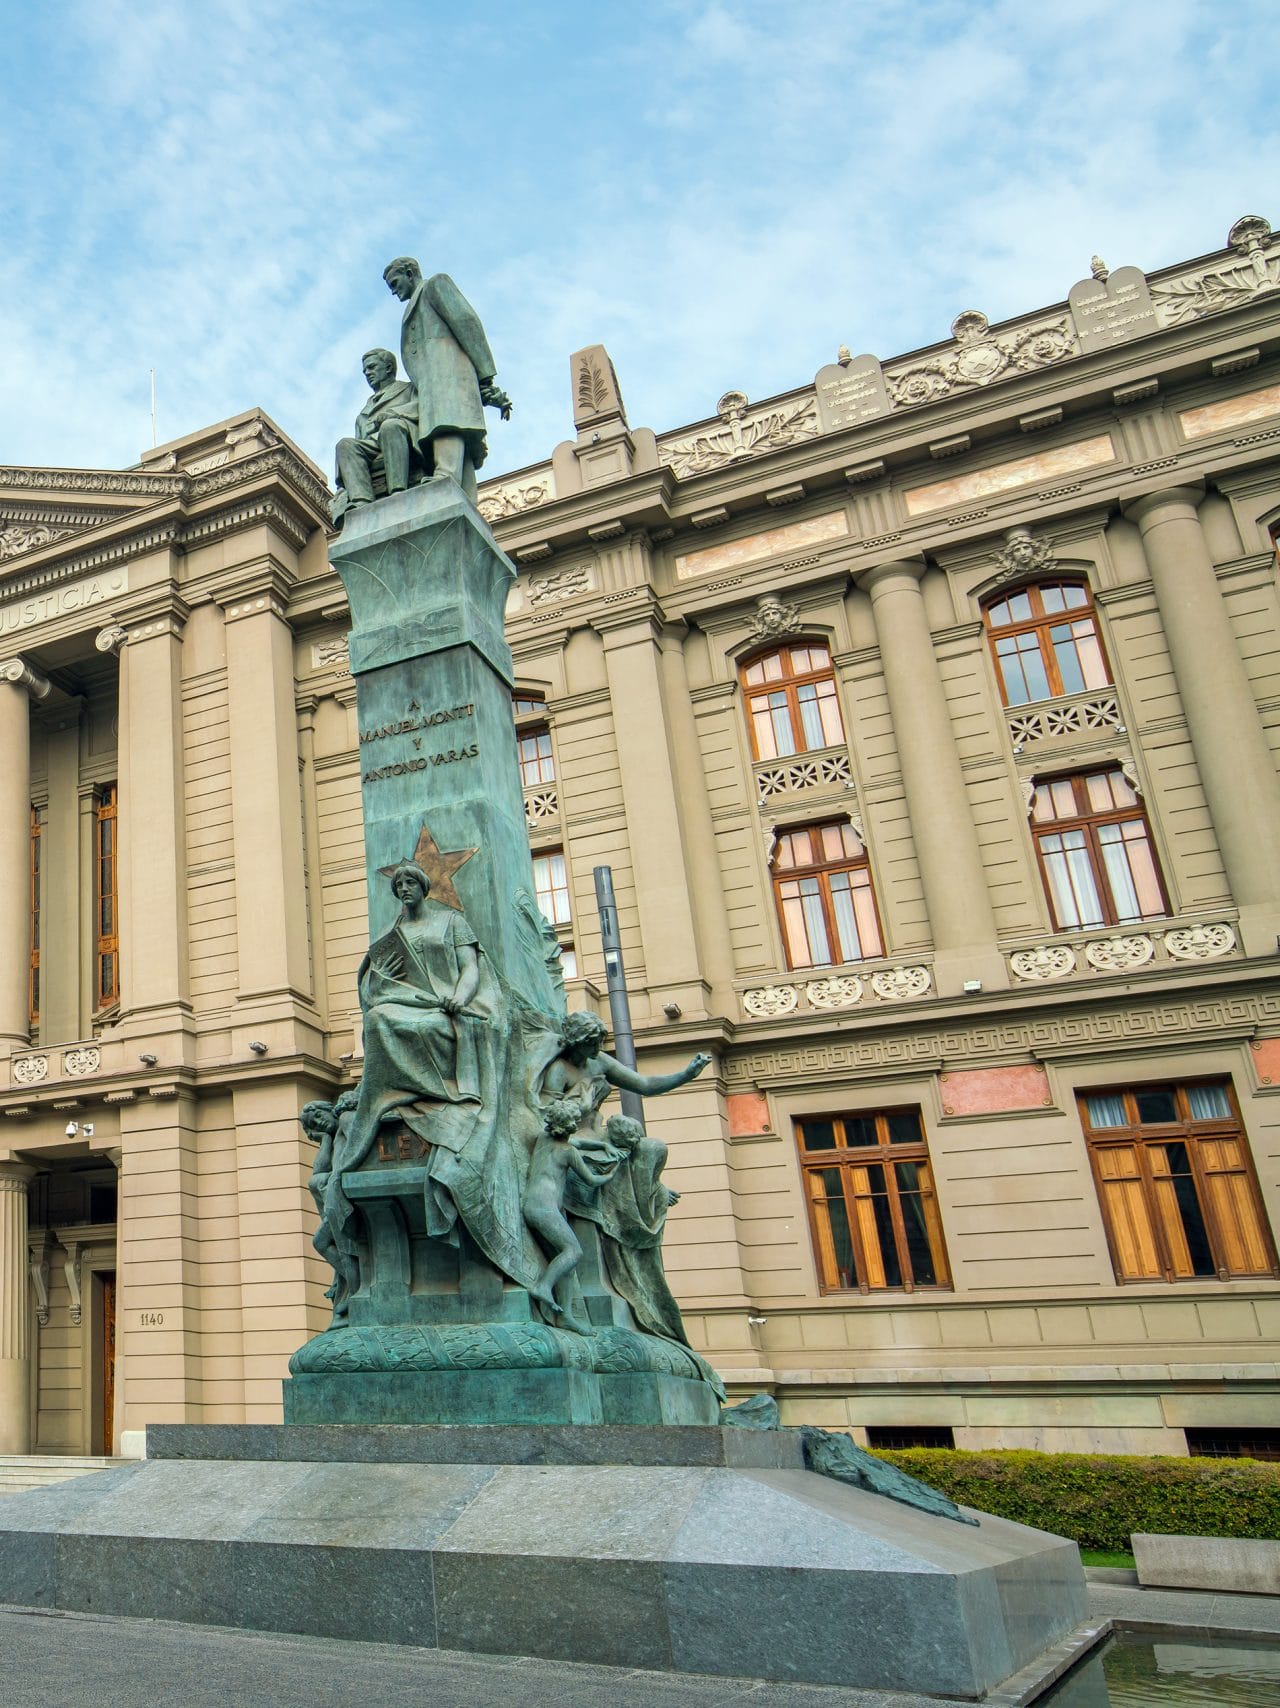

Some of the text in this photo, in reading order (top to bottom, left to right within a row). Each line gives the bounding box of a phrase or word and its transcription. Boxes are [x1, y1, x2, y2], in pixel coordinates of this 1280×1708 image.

[408, 698, 420, 711] A
[359, 704, 474, 745] MANUEL MONTT
[412, 738, 422, 750] Y
[362, 744, 480, 784] ANTONIO VARAS
[141, 1313, 164, 1326] 1140
